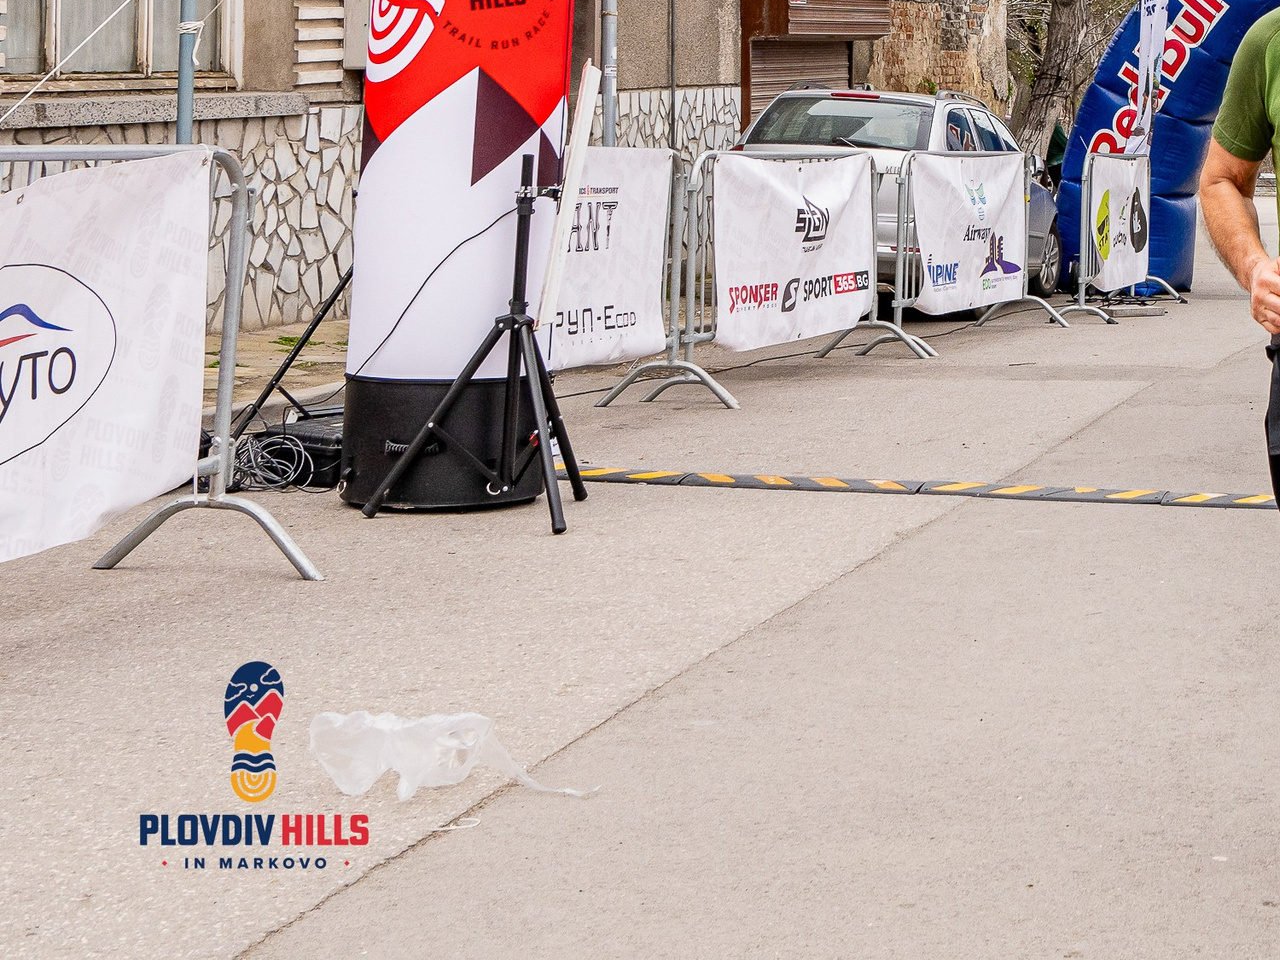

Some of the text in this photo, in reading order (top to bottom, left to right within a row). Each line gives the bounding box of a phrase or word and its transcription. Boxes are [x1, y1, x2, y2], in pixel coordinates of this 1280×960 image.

[443, 10, 550, 50] TRAIL RUN RACE
[590, 187, 619, 195] TRANSPORT
[728, 282, 779, 314] SPONSER
